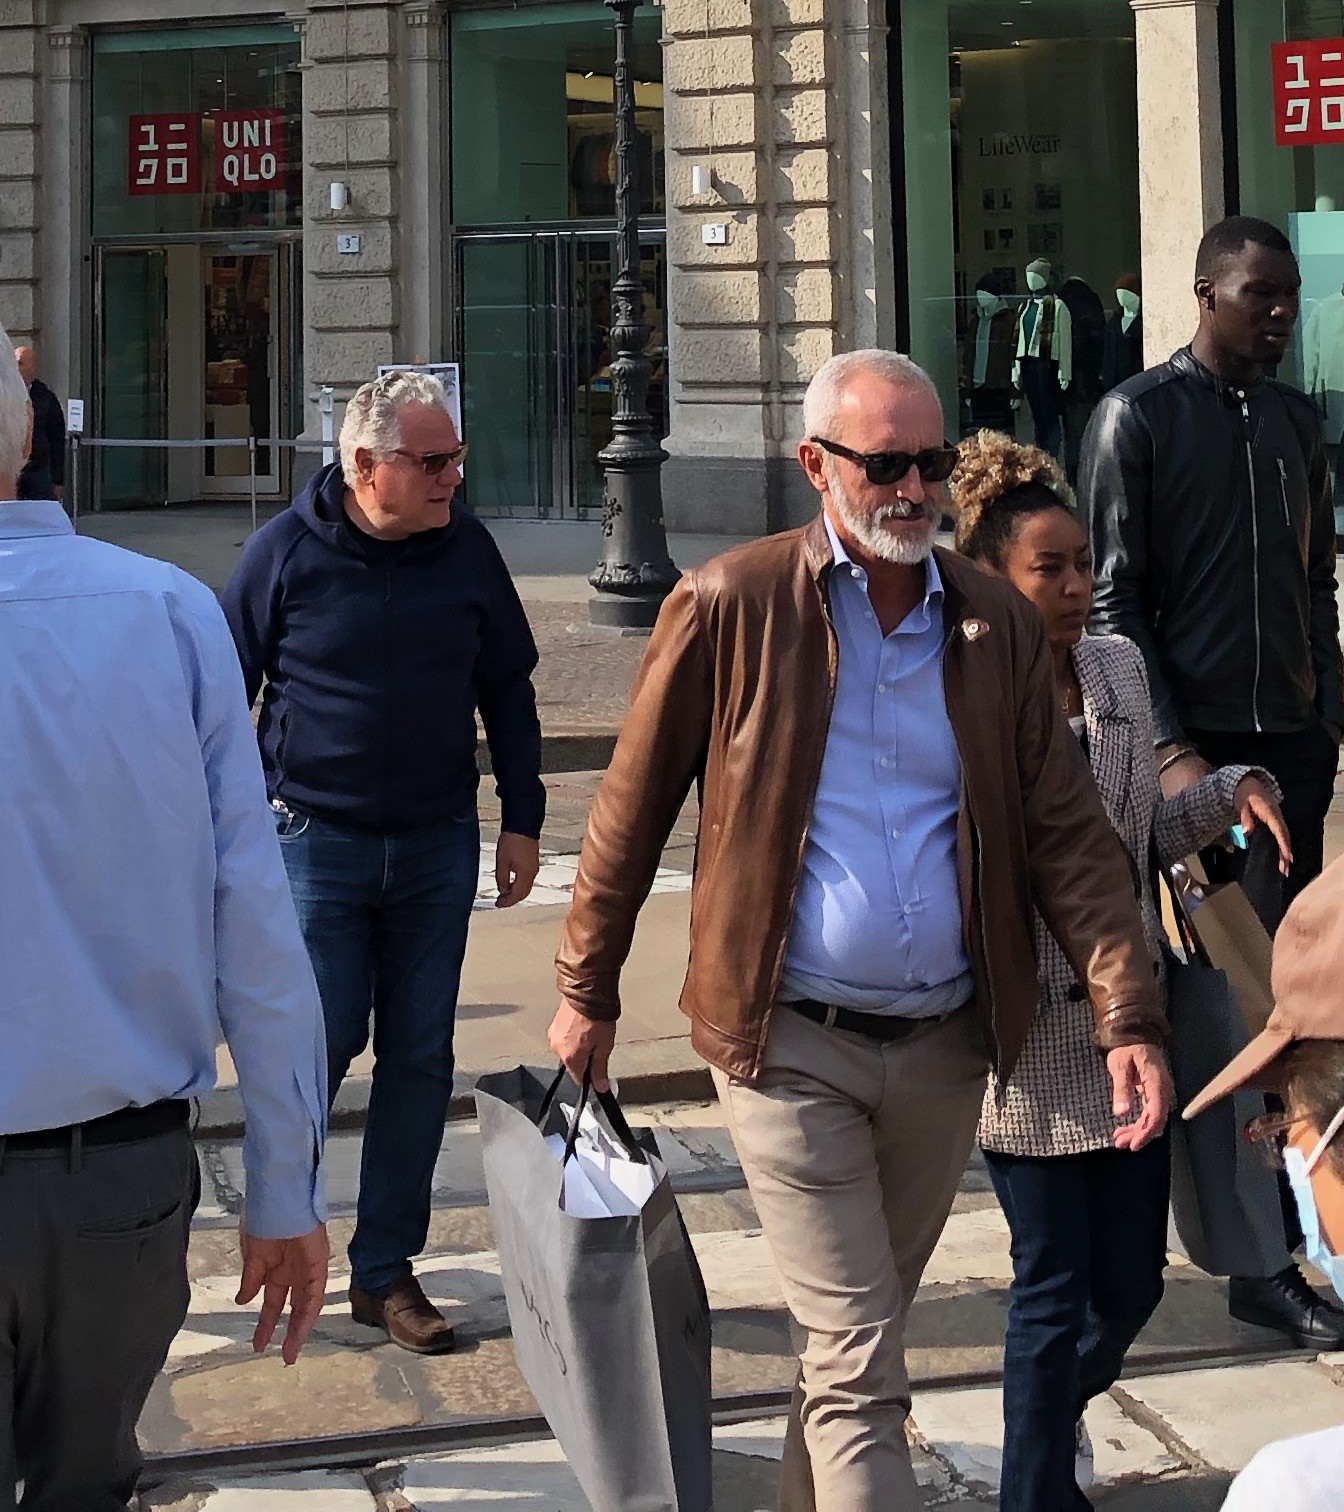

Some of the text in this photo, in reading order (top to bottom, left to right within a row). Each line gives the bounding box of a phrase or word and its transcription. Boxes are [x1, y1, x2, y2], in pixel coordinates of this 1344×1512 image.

[222, 119, 271, 148] UNI
[979, 135, 1061, 157] LifeWear
[223, 152, 276, 186] QLO
